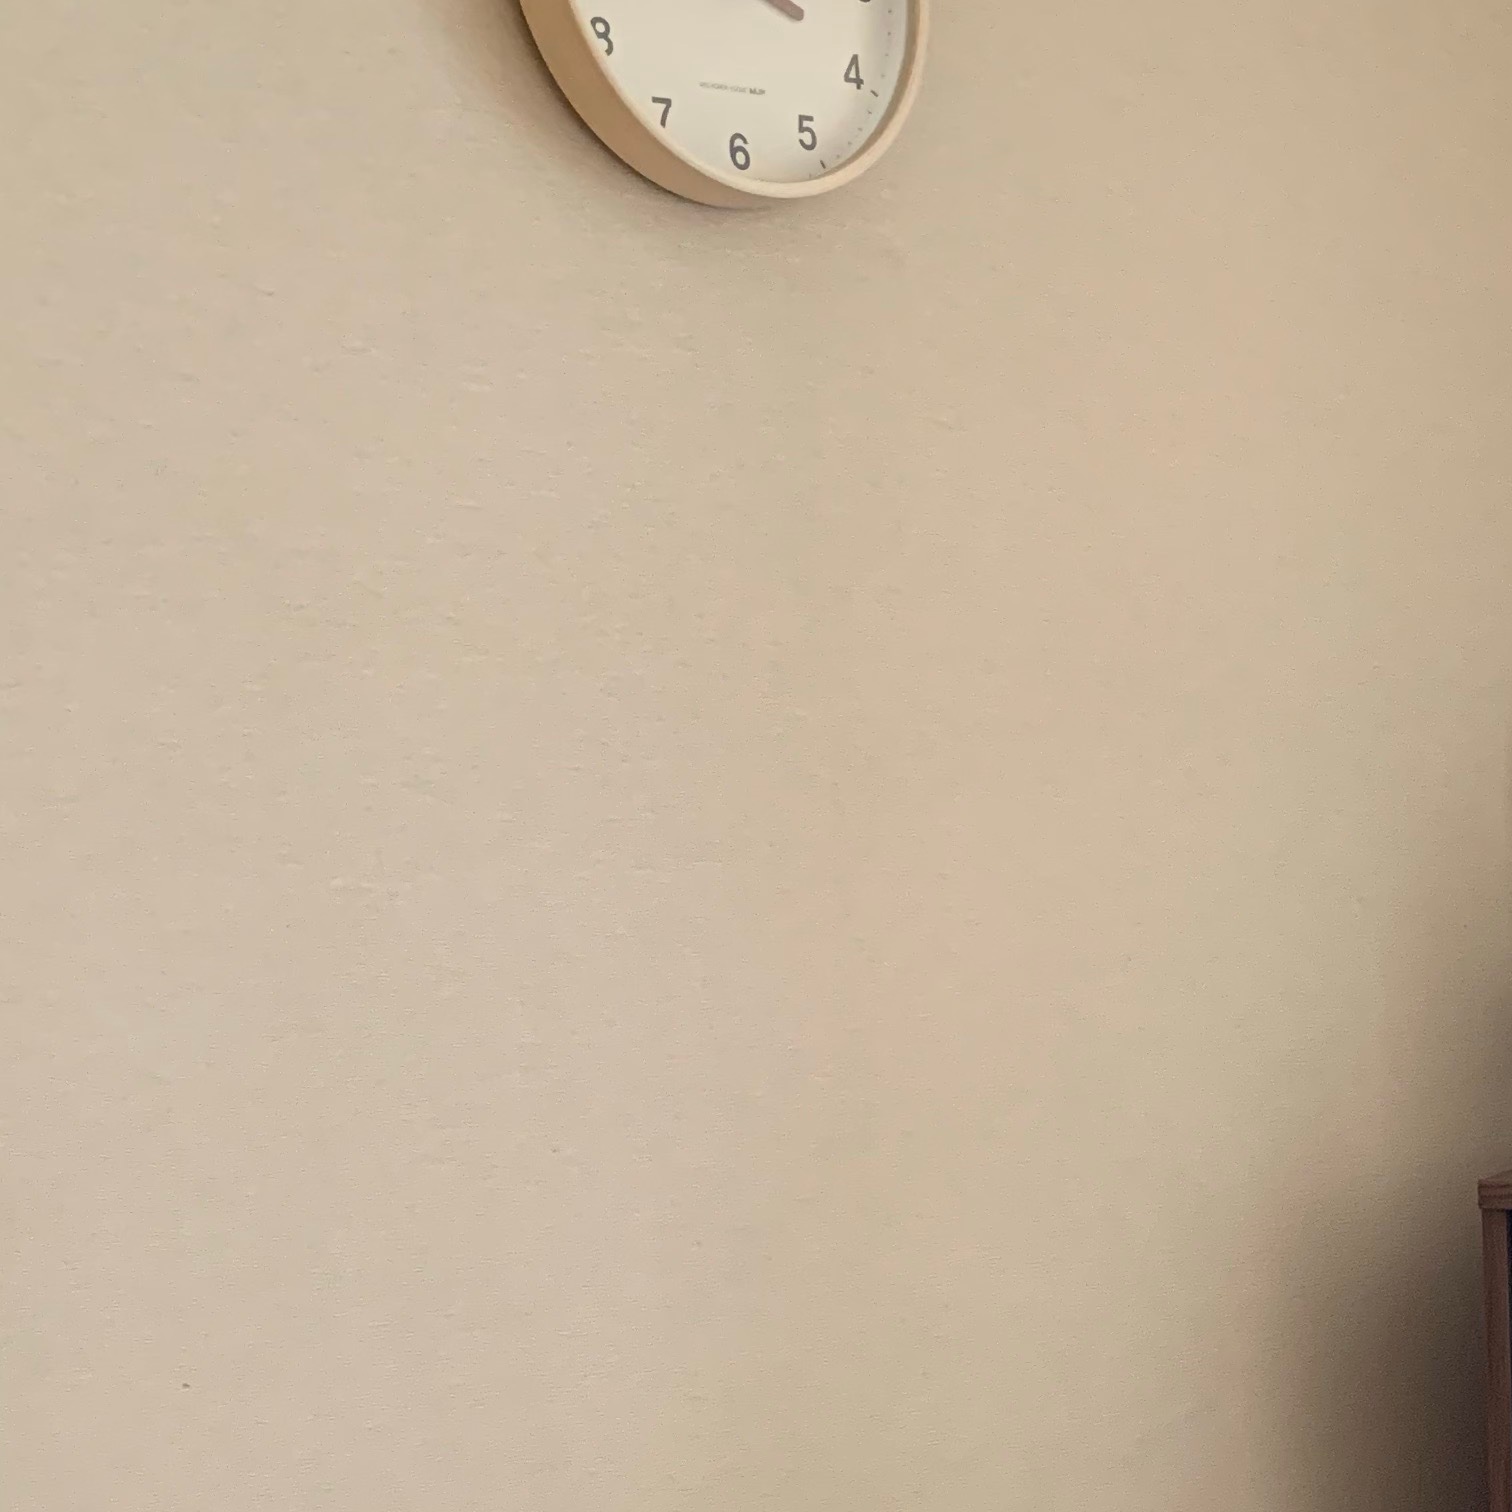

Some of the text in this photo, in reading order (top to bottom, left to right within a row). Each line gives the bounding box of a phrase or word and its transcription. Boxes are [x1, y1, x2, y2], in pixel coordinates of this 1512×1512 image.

[590, 16, 614, 56] 8
[843, 54, 865, 90] 4
[651, 96, 672, 128] 7
[798, 115, 818, 151] 5
[729, 133, 751, 171] 6
